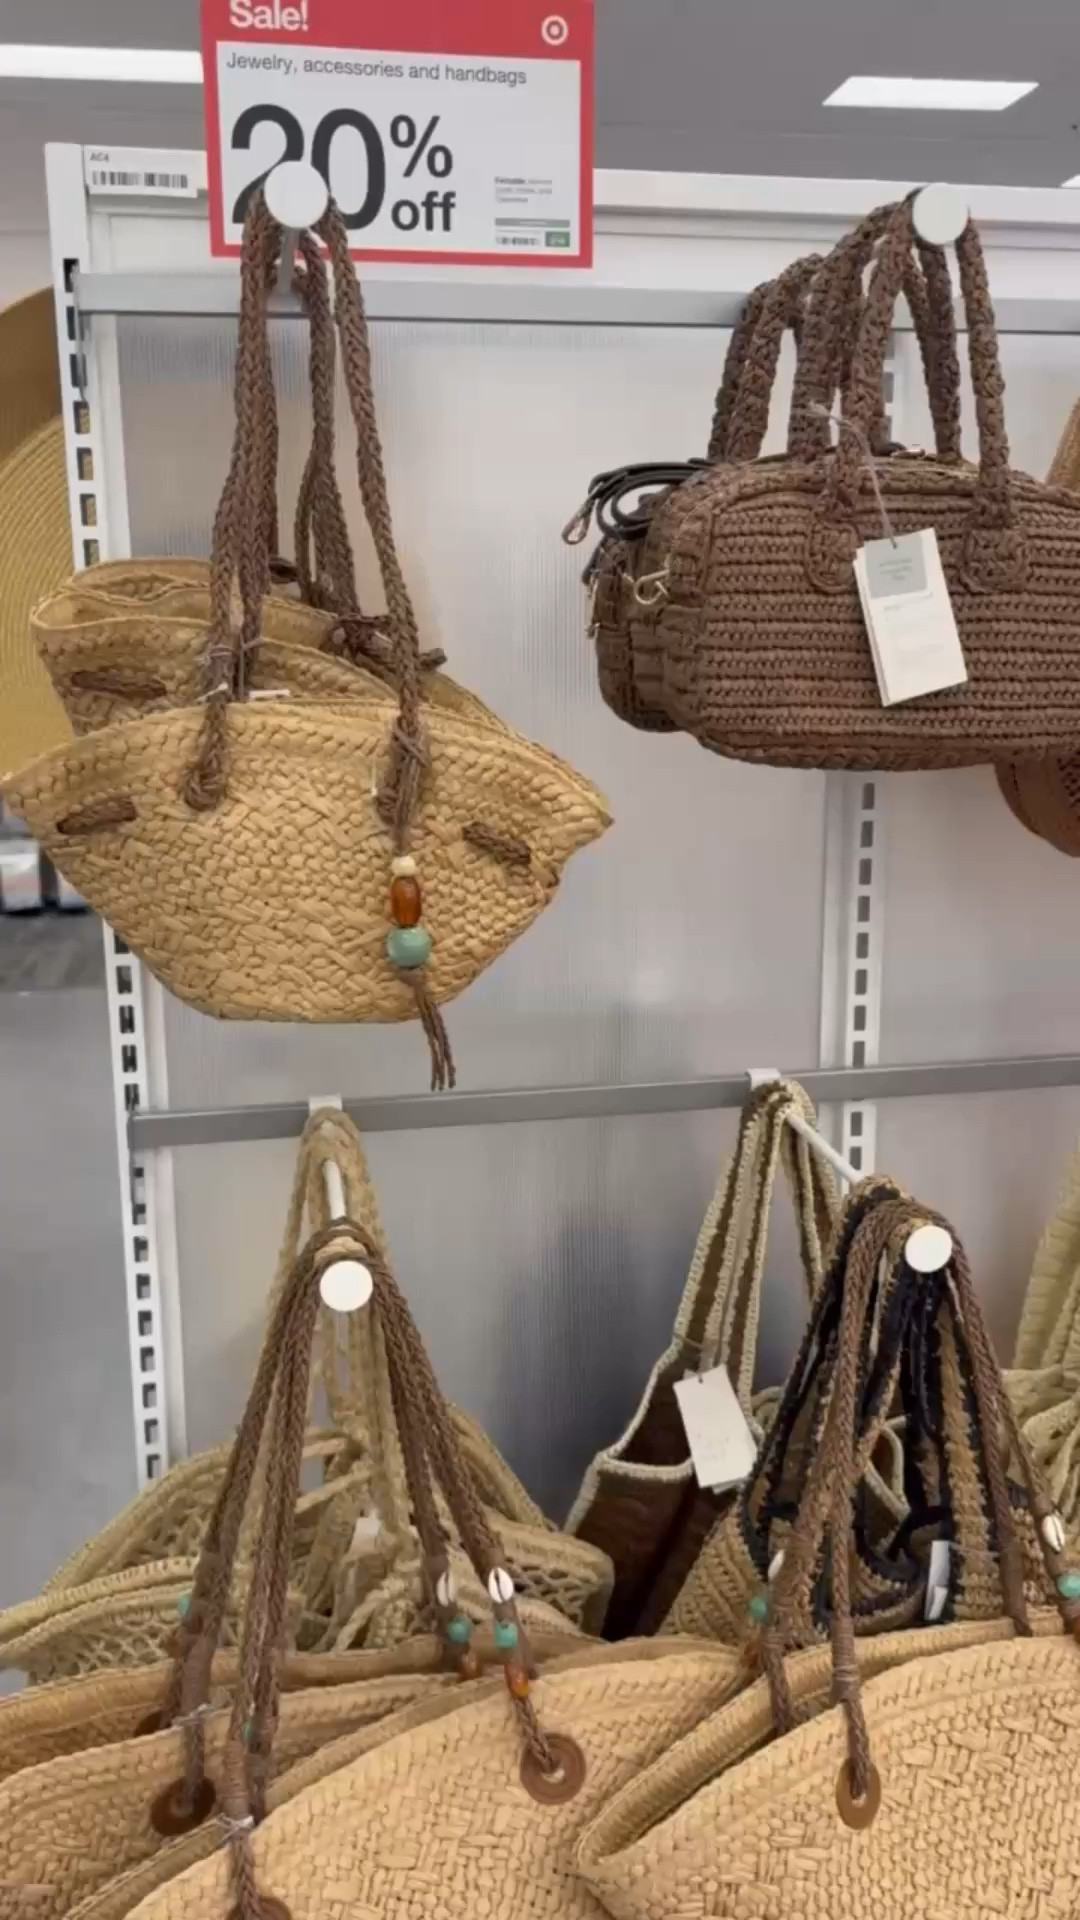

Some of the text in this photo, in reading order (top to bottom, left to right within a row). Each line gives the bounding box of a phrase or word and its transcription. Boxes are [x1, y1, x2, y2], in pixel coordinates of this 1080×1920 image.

[229, 0, 308, 31] Sale!
[226, 52, 527, 87] Jewelry, accessories and handbags
[392, 191, 455, 232] off
